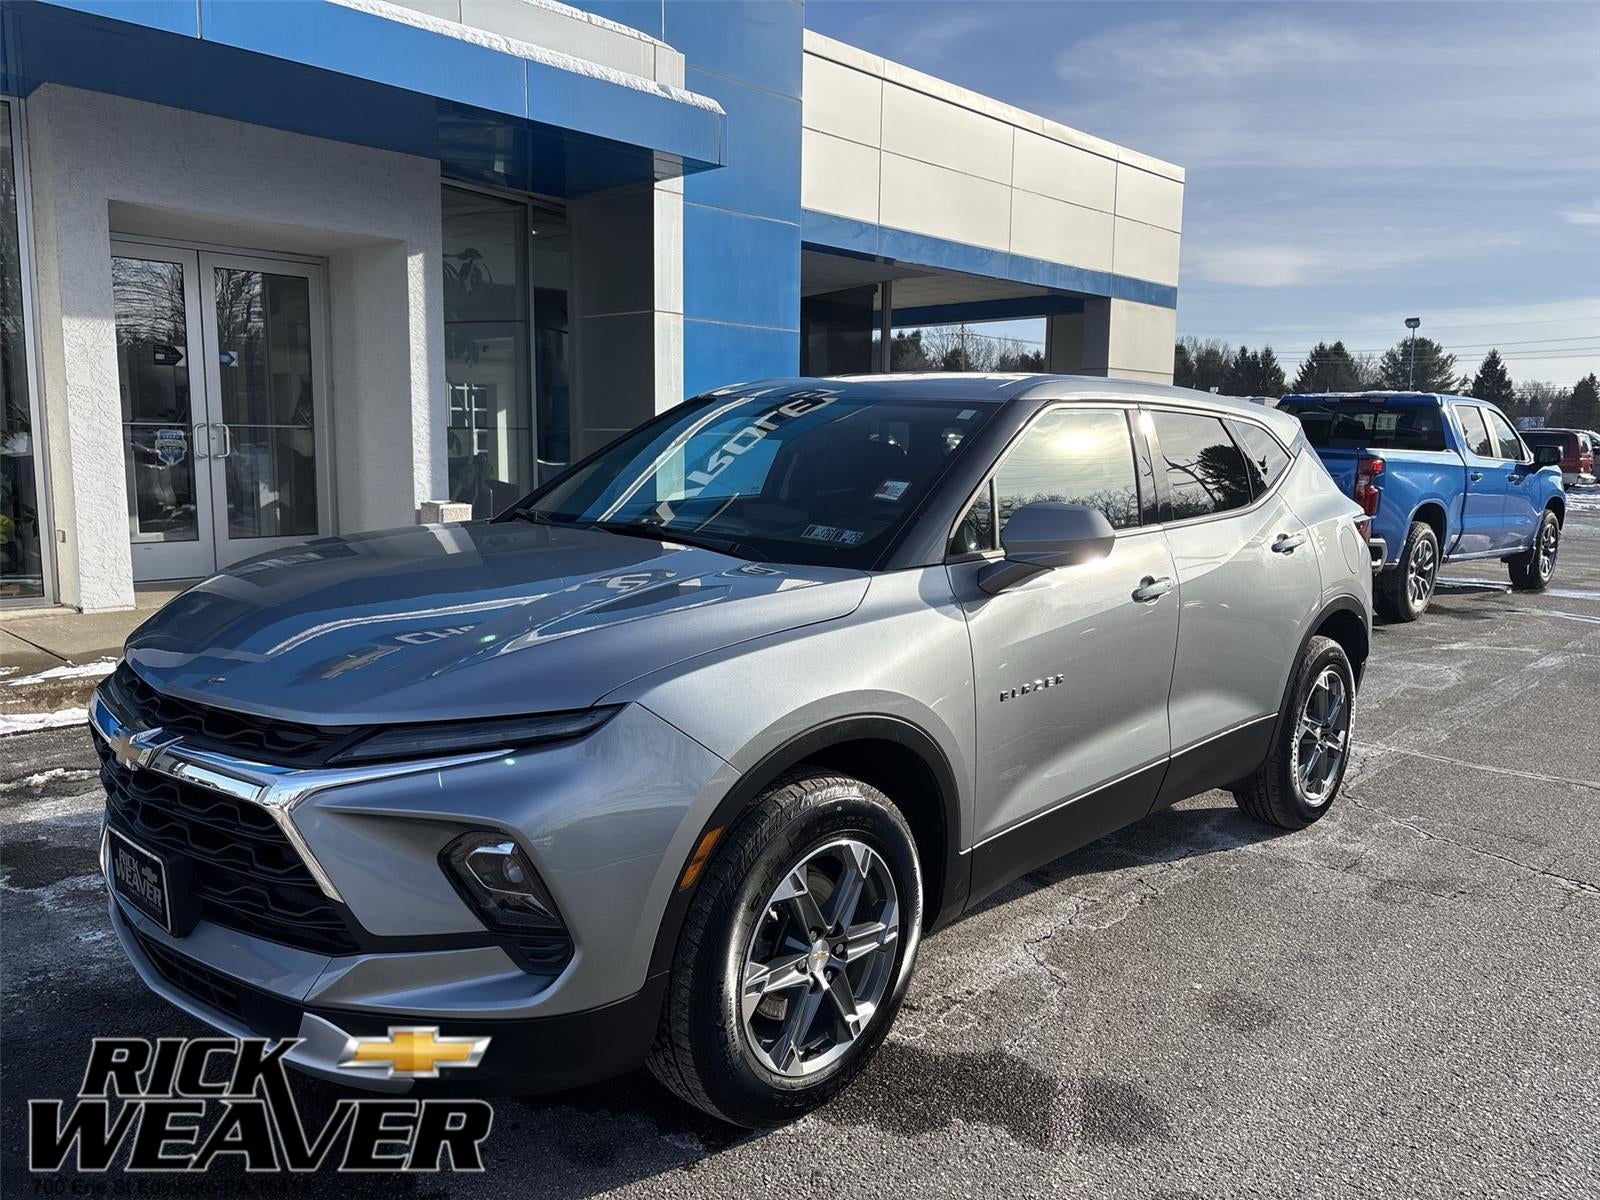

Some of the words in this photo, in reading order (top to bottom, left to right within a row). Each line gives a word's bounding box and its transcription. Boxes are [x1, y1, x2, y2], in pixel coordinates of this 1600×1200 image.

[999, 673, 1065, 703] BLAZER
[118, 847, 139, 872] RICK
[115, 858, 162, 908] WEAVER
